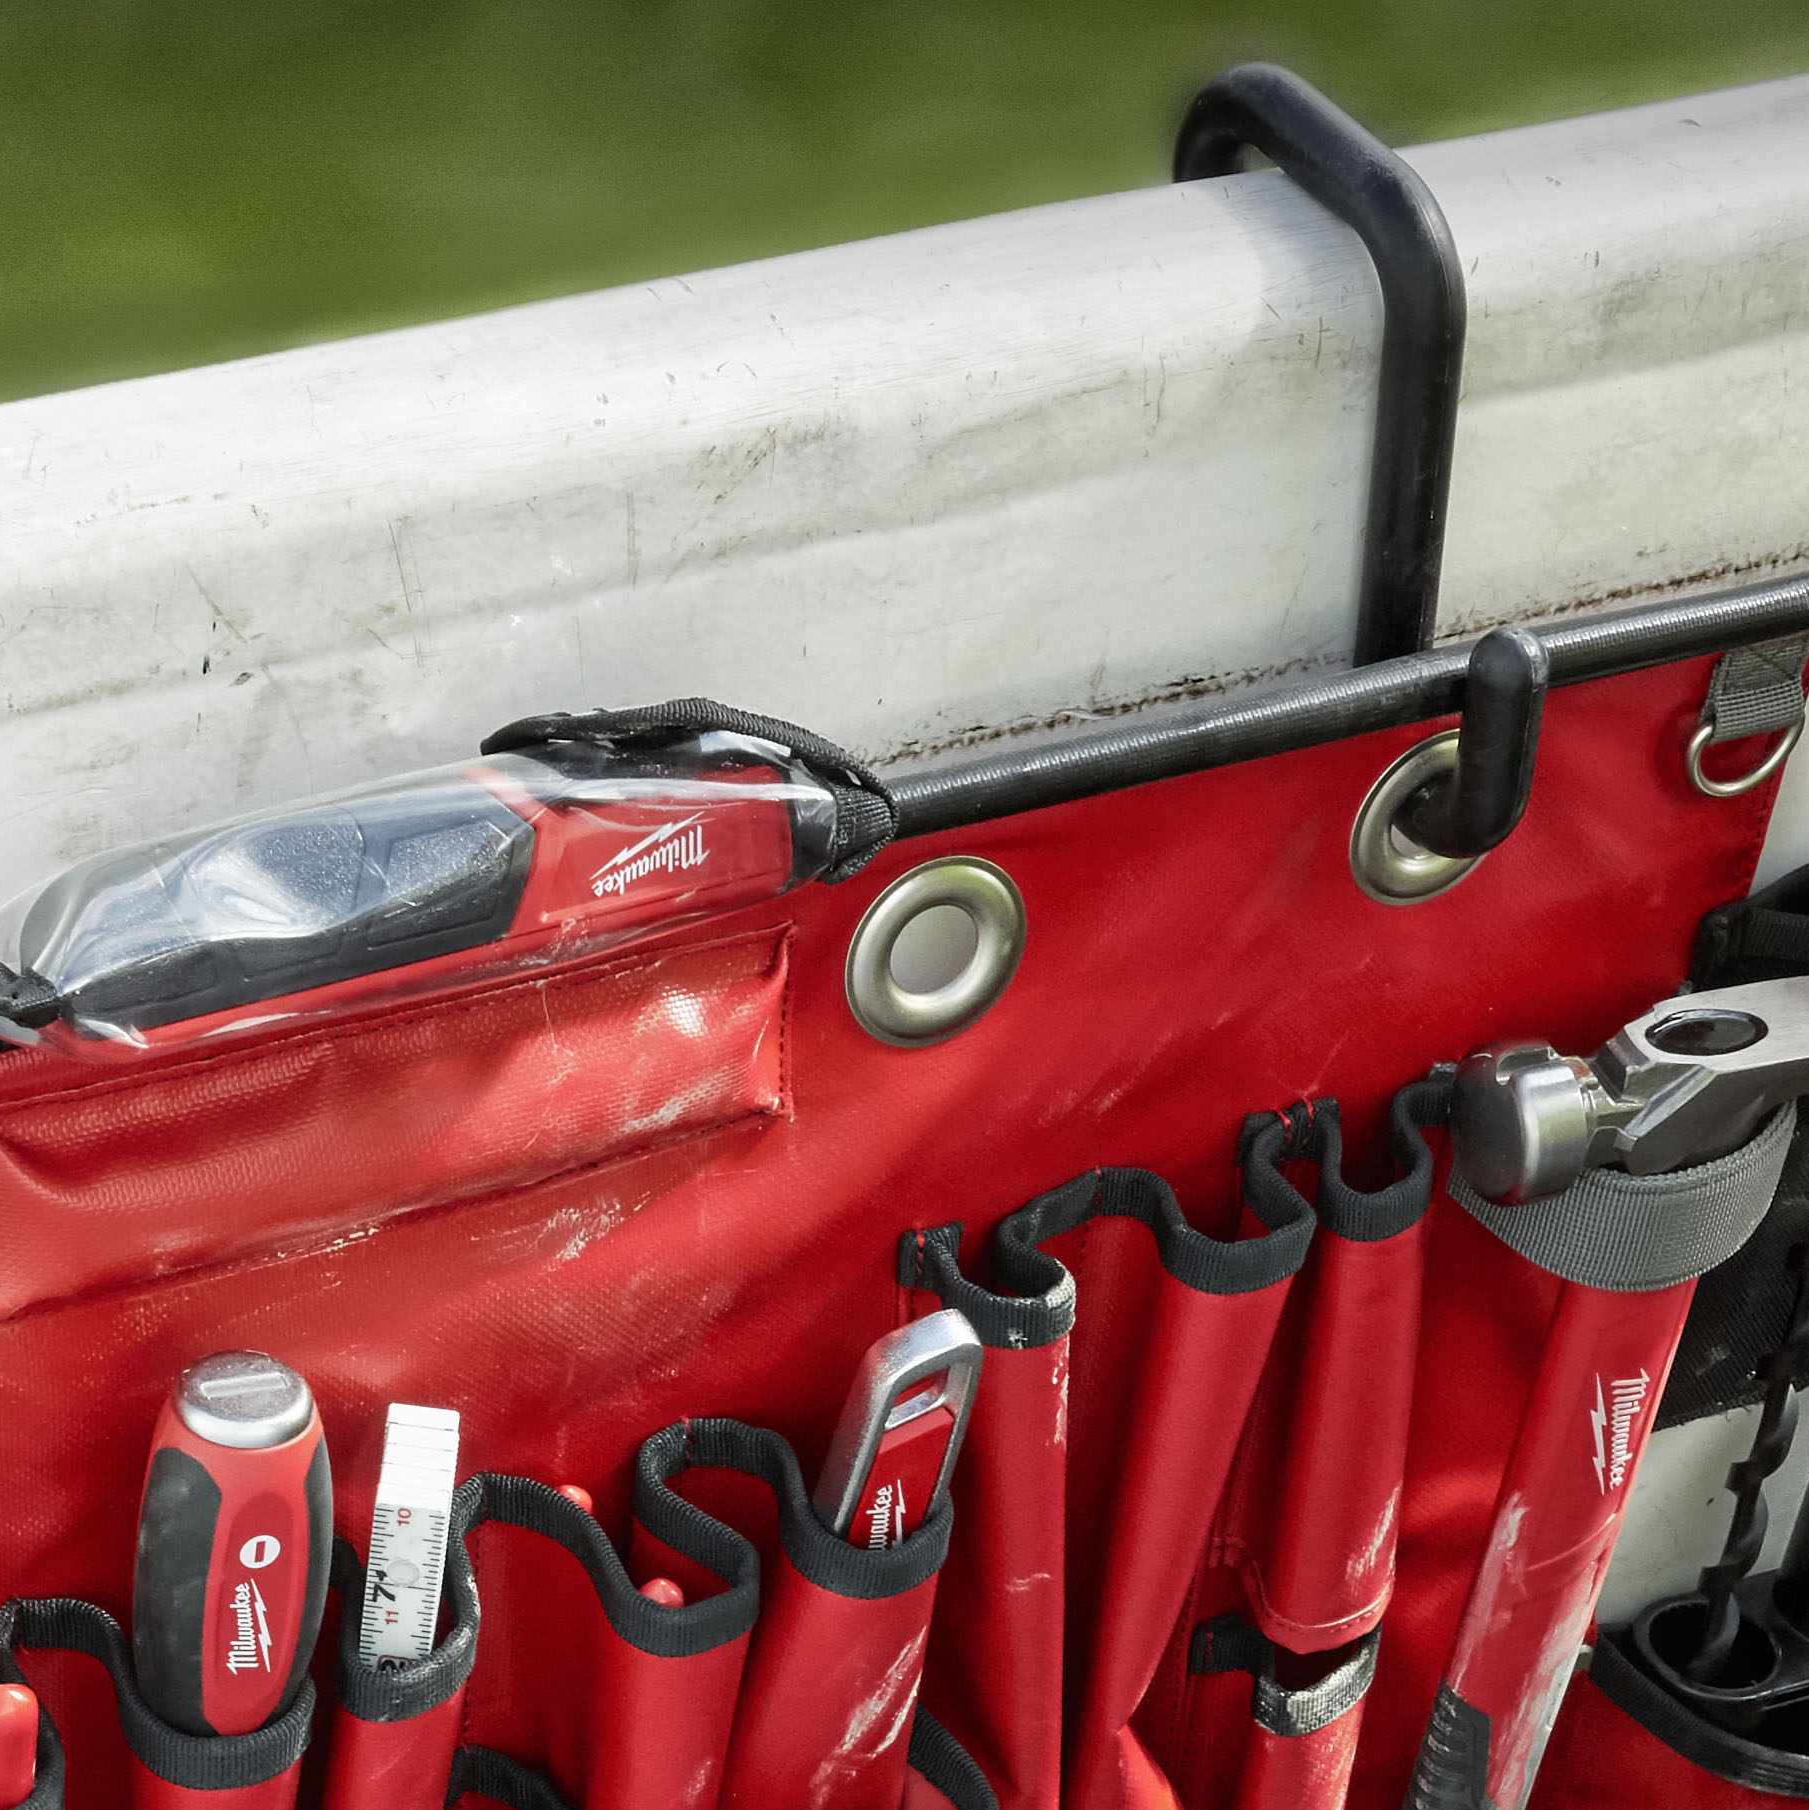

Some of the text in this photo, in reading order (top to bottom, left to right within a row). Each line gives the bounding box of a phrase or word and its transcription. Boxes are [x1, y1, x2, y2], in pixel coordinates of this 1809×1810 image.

[592, 825, 710, 897] Milwaukee
[1610, 1368, 1650, 1491] Milwaukee
[396, 1508, 412, 1527] 10
[866, 1484, 893, 1551] waukee
[226, 1582, 259, 1675] Milwaukee
[384, 1610, 399, 1625] 11
